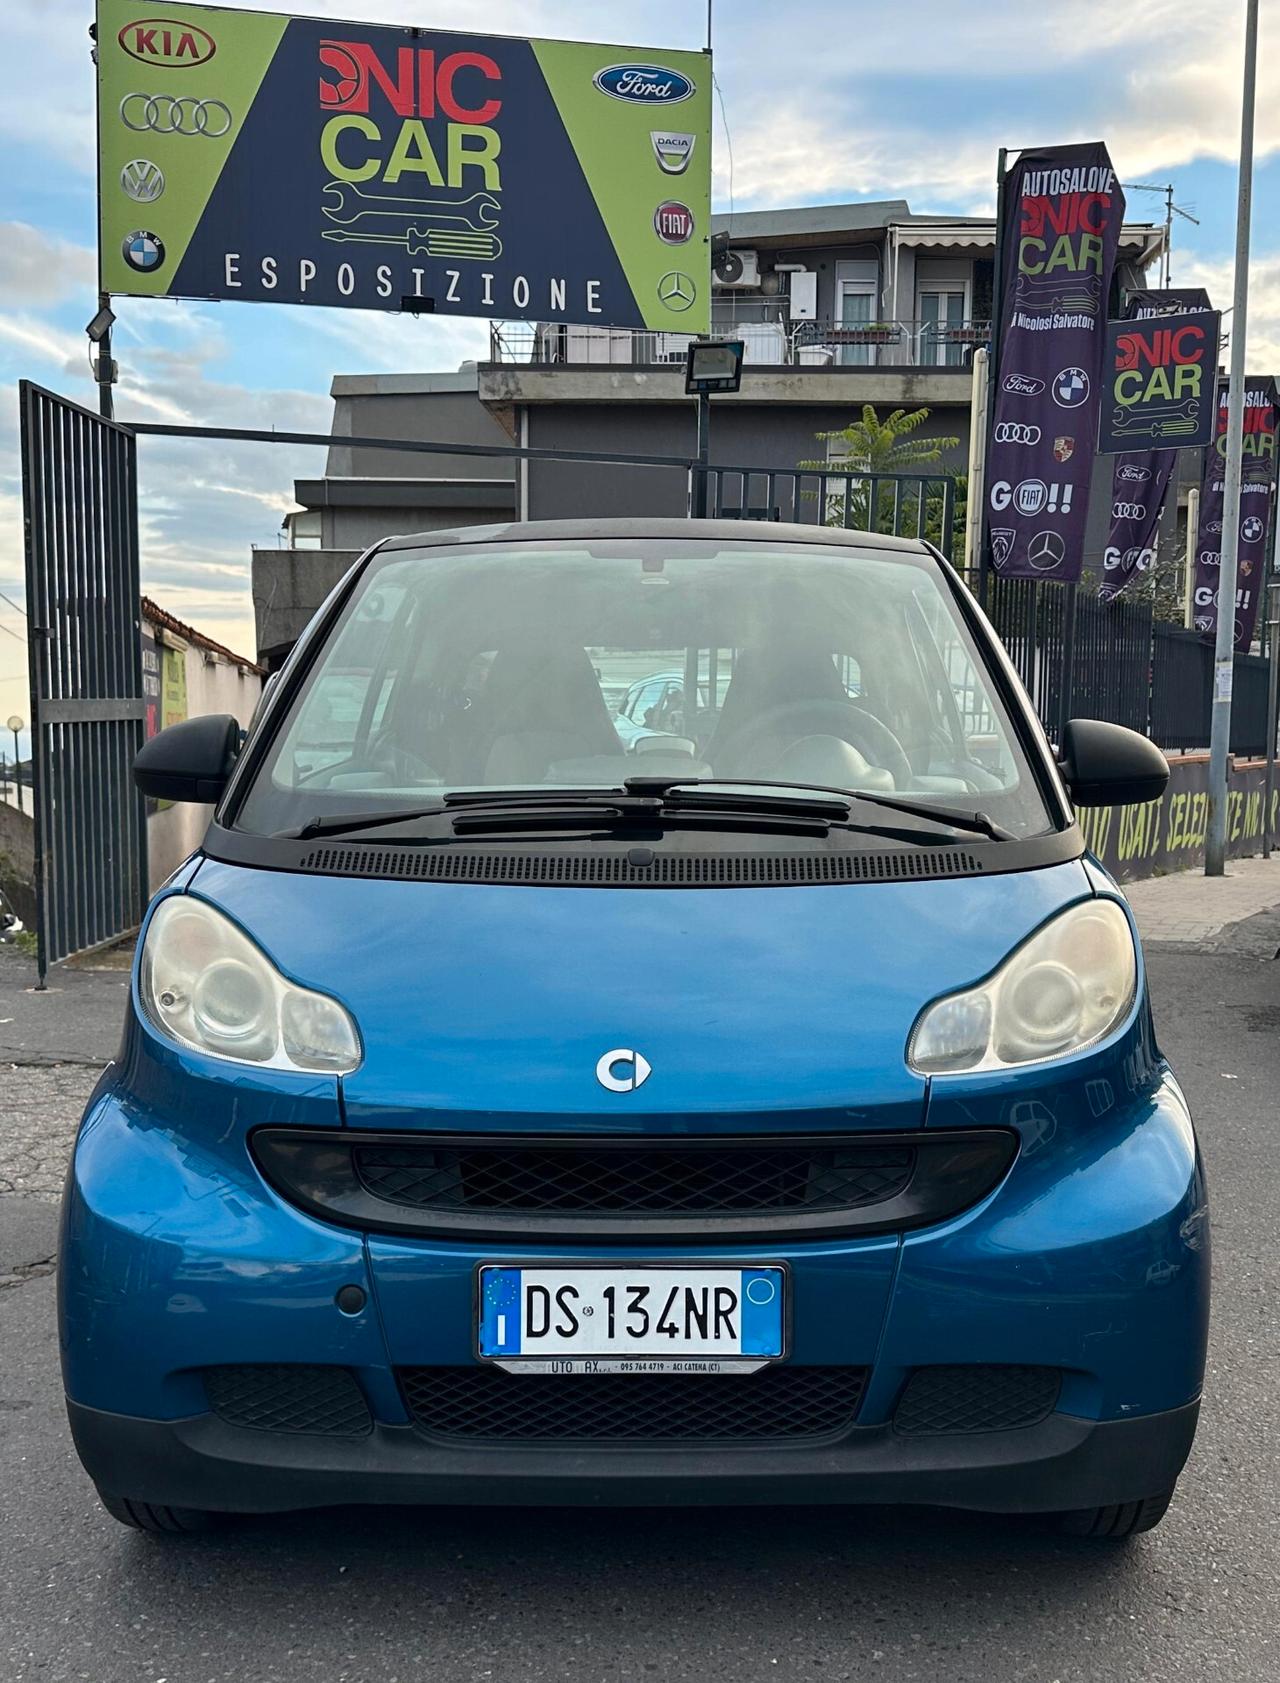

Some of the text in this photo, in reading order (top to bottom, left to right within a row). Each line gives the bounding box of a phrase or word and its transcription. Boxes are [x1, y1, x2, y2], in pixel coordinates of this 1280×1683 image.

[135, 28, 200, 58] KIA
[320, 40, 502, 124] NIC
[616, 70, 673, 98] Ford
[320, 115, 502, 191] CAR
[657, 137, 689, 147] DACIA
[662, 213, 687, 235] FIAT
[1021, 192, 1111, 237] NIC
[1018, 232, 1103, 275] CAR
[225, 253, 602, 313] ESPOSIZIONE
[1017, 312, 1053, 331] Nicolosi
[1115, 326, 1205, 371] NIC
[1006, 375, 1037, 394] Ford
[1114, 363, 1202, 405] CAR
[526, 1285, 738, 1340] DS 134NR
[621, 1362, 633, 1371] 095
[635, 1362, 647, 1371] 764
[649, 1362, 664, 1371] 4719
[673, 1362, 683, 1371] ACI
[709, 1362, 721, 1372] (CT)
